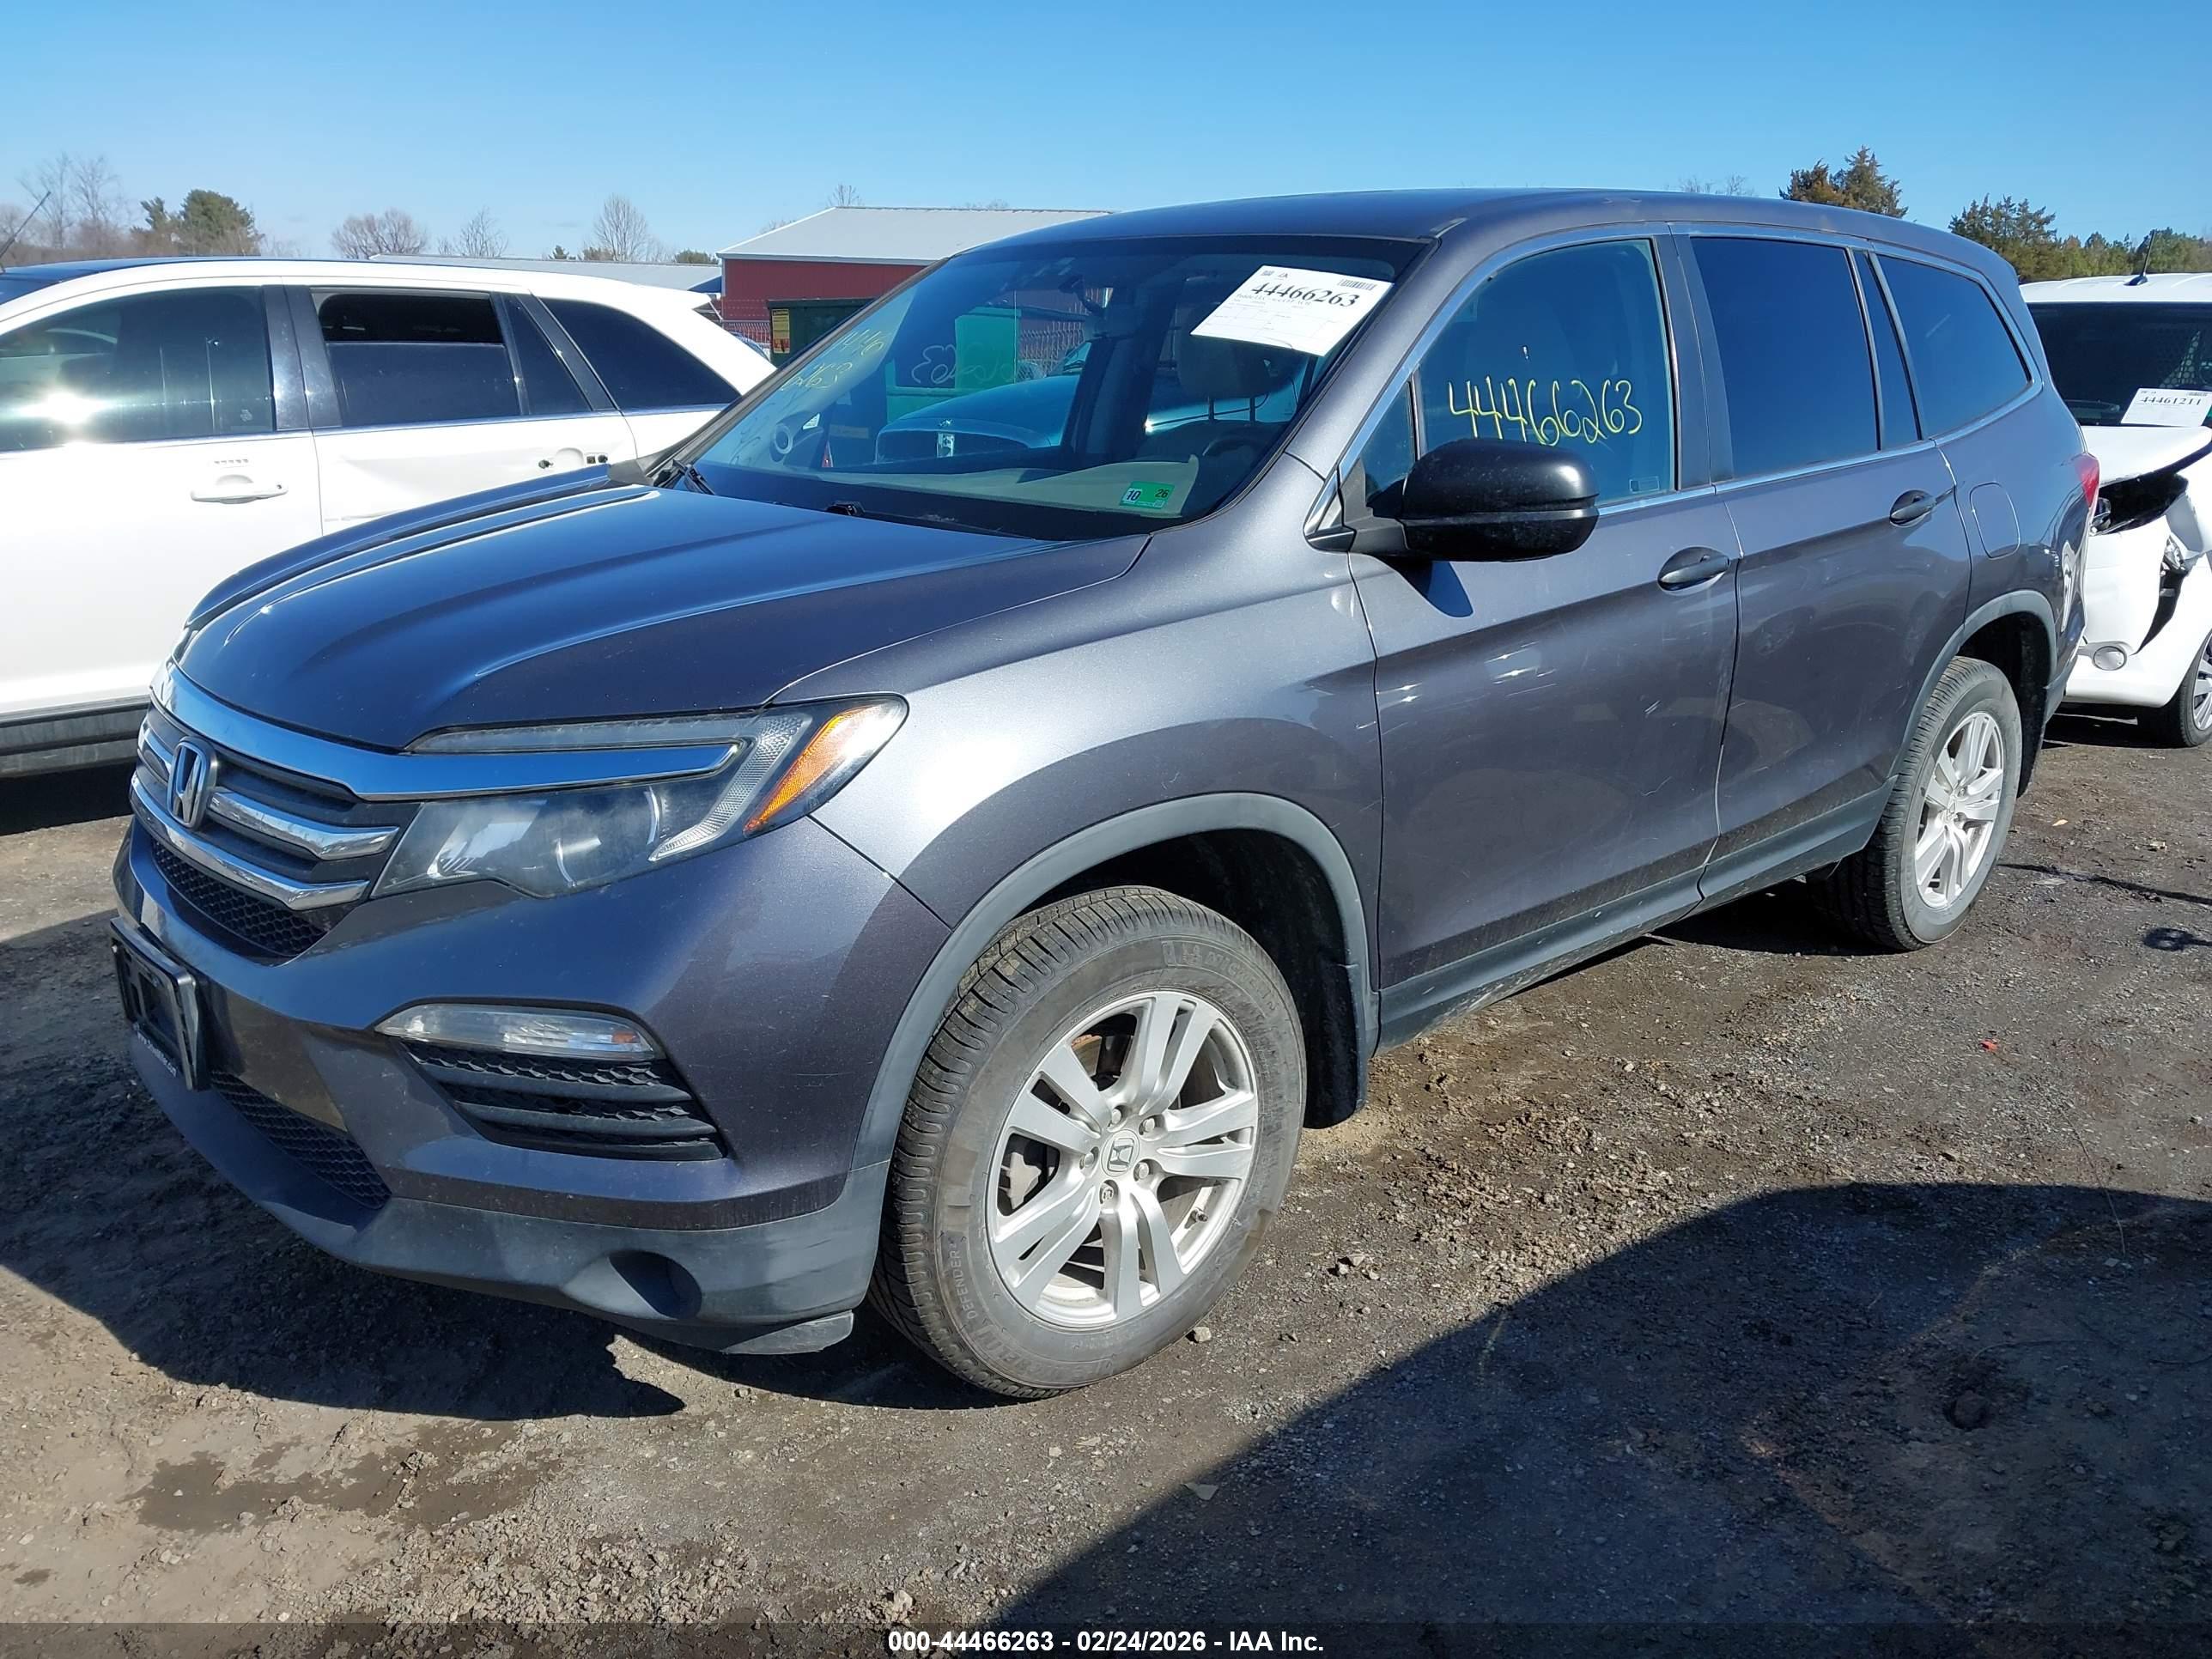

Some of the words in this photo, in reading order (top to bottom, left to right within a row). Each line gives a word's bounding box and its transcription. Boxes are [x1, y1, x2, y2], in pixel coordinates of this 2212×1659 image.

[1250, 282, 1360, 307] 44466263
[2140, 396, 2202, 405] 44461211
[1448, 375, 1643, 447] 44466263
[1126, 489, 1142, 501] 10
[1155, 489, 1169, 499] 26
